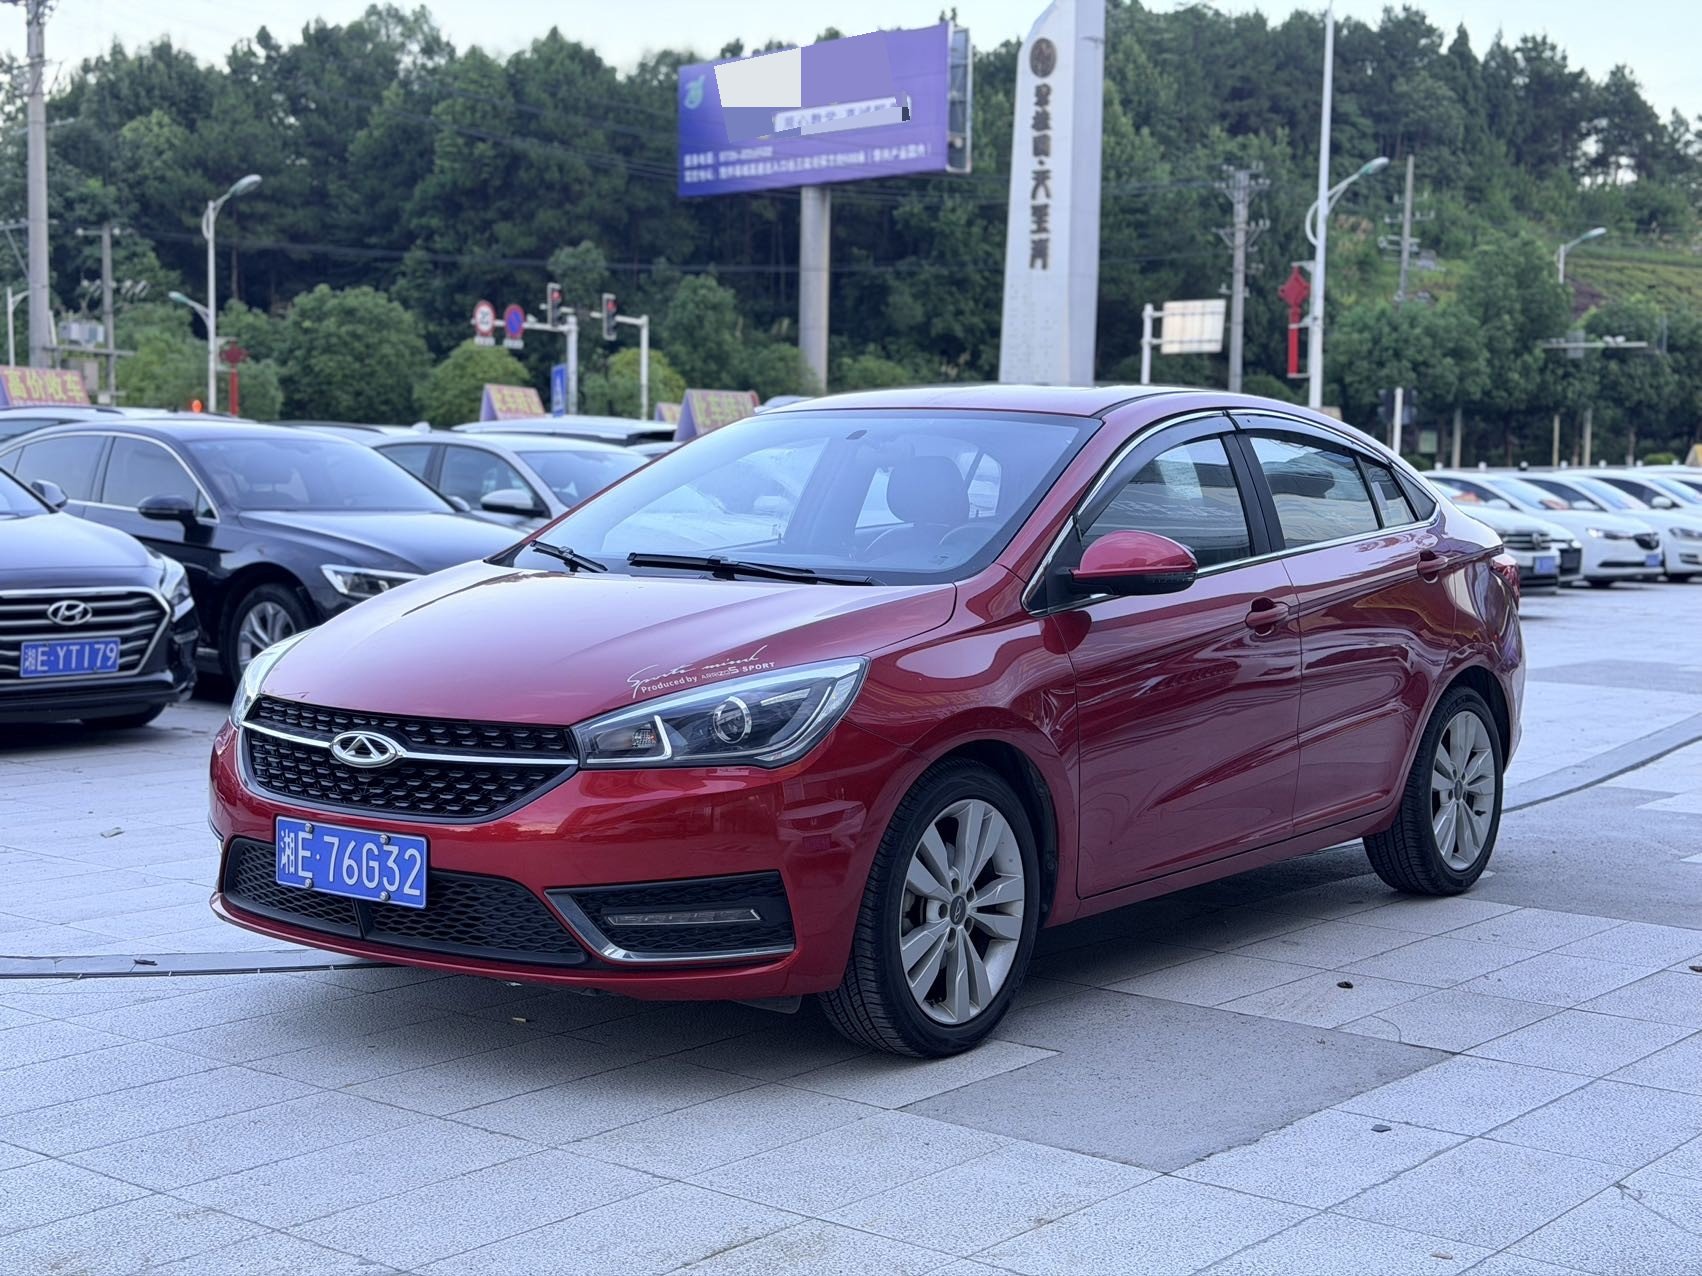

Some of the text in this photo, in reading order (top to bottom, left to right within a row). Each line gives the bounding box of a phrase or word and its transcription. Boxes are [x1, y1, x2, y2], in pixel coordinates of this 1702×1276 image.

[24, 642, 118, 671] 湘E·YT179
[701, 644, 768, 670] mind
[641, 676, 686, 694] Produced
[686, 674, 698, 683] by
[742, 661, 776, 673] SPORT
[281, 828, 422, 896] 湘E·76G32
